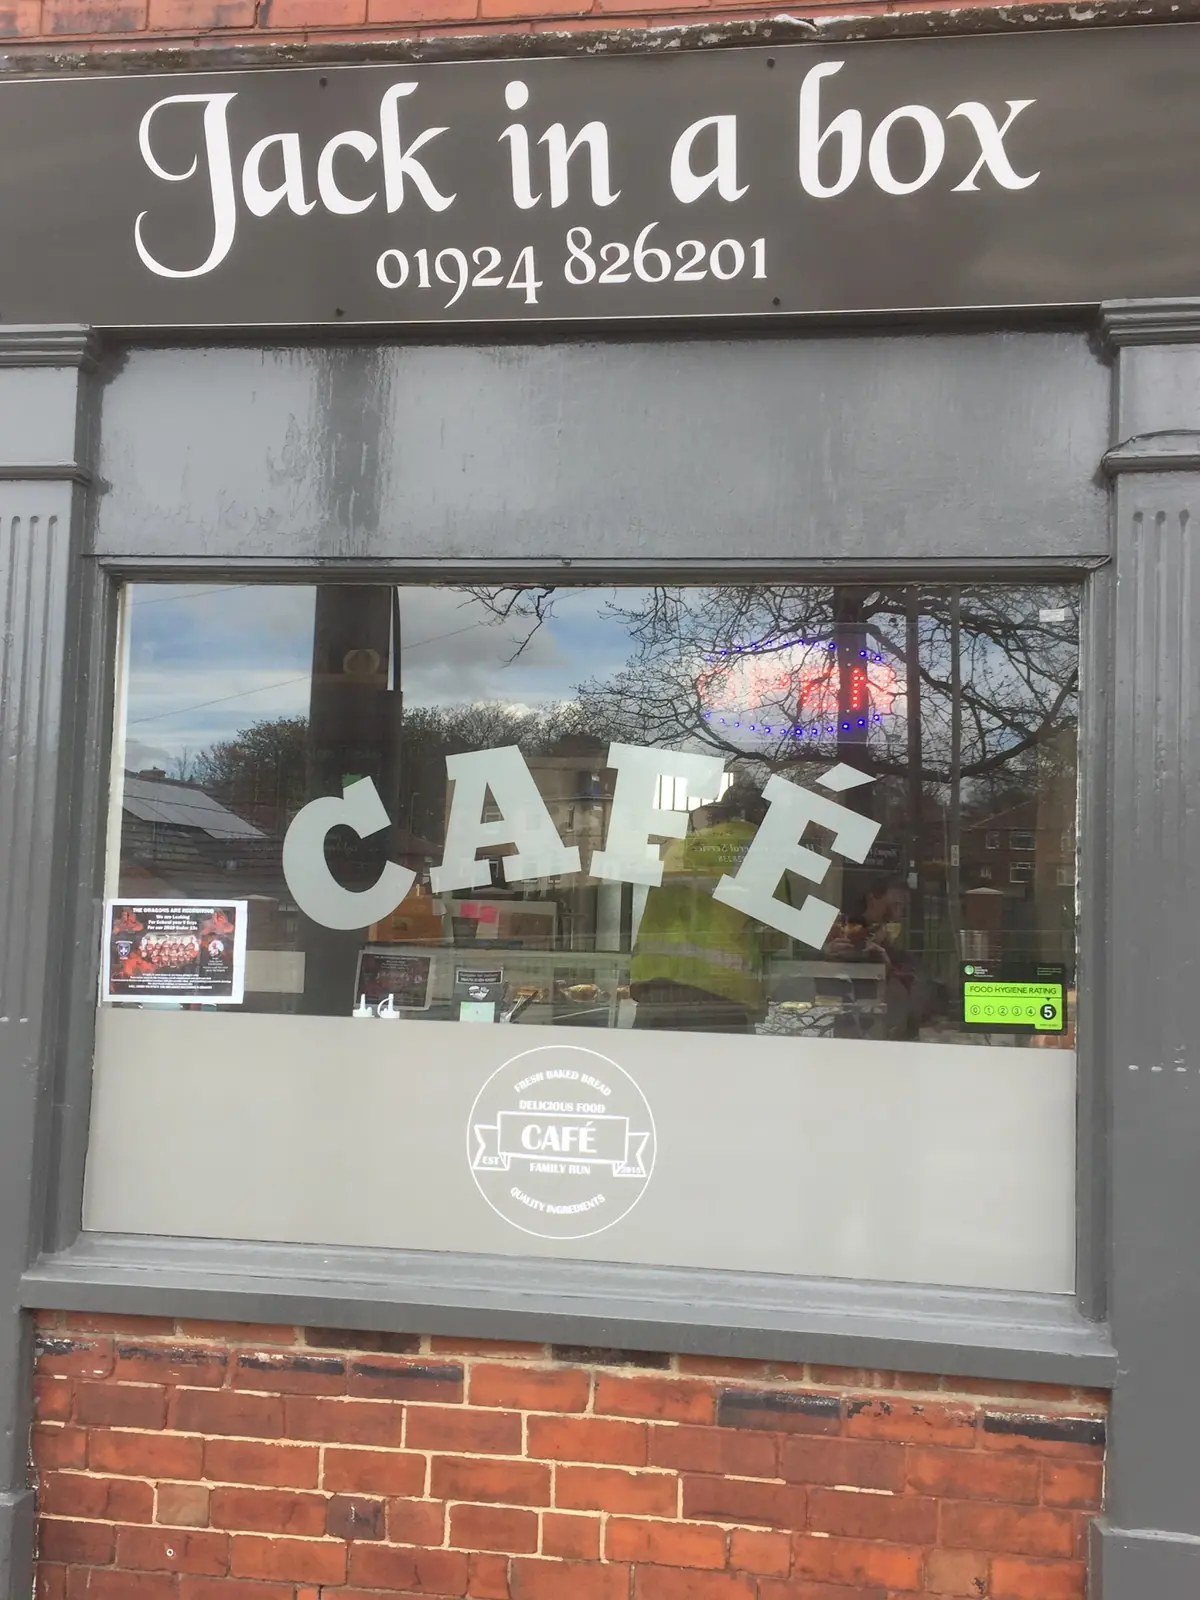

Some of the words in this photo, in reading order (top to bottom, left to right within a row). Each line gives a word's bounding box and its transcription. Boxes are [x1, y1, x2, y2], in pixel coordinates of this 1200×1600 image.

[135, 82, 456, 278] Jack
[498, 81, 621, 209] in
[671, 115, 749, 204] a
[799, 61, 1040, 198] box
[377, 246, 543, 306] 01924
[565, 222, 768, 284] 826201
[283, 742, 881, 950] CAFÉ
[969, 985, 993, 993] FOOD
[994, 986, 1028, 995] HYGIENE
[1028, 986, 1057, 995] RATING
[1043, 1006, 1053, 1018] 5
[513, 1072, 544, 1093] FRESH
[546, 1069, 579, 1080] BAKED
[580, 1073, 612, 1097] BREAD
[519, 1100, 574, 1112] DELICIOUS
[576, 1102, 606, 1113] FOOD
[521, 1121, 597, 1154] CAFÉ
[482, 1156, 500, 1165] EST
[529, 1163, 566, 1174] FAMILY
[568, 1164, 591, 1175] RUN
[510, 1186, 545, 1212] QUALITY
[546, 1193, 605, 1214] INGREDIENTS
